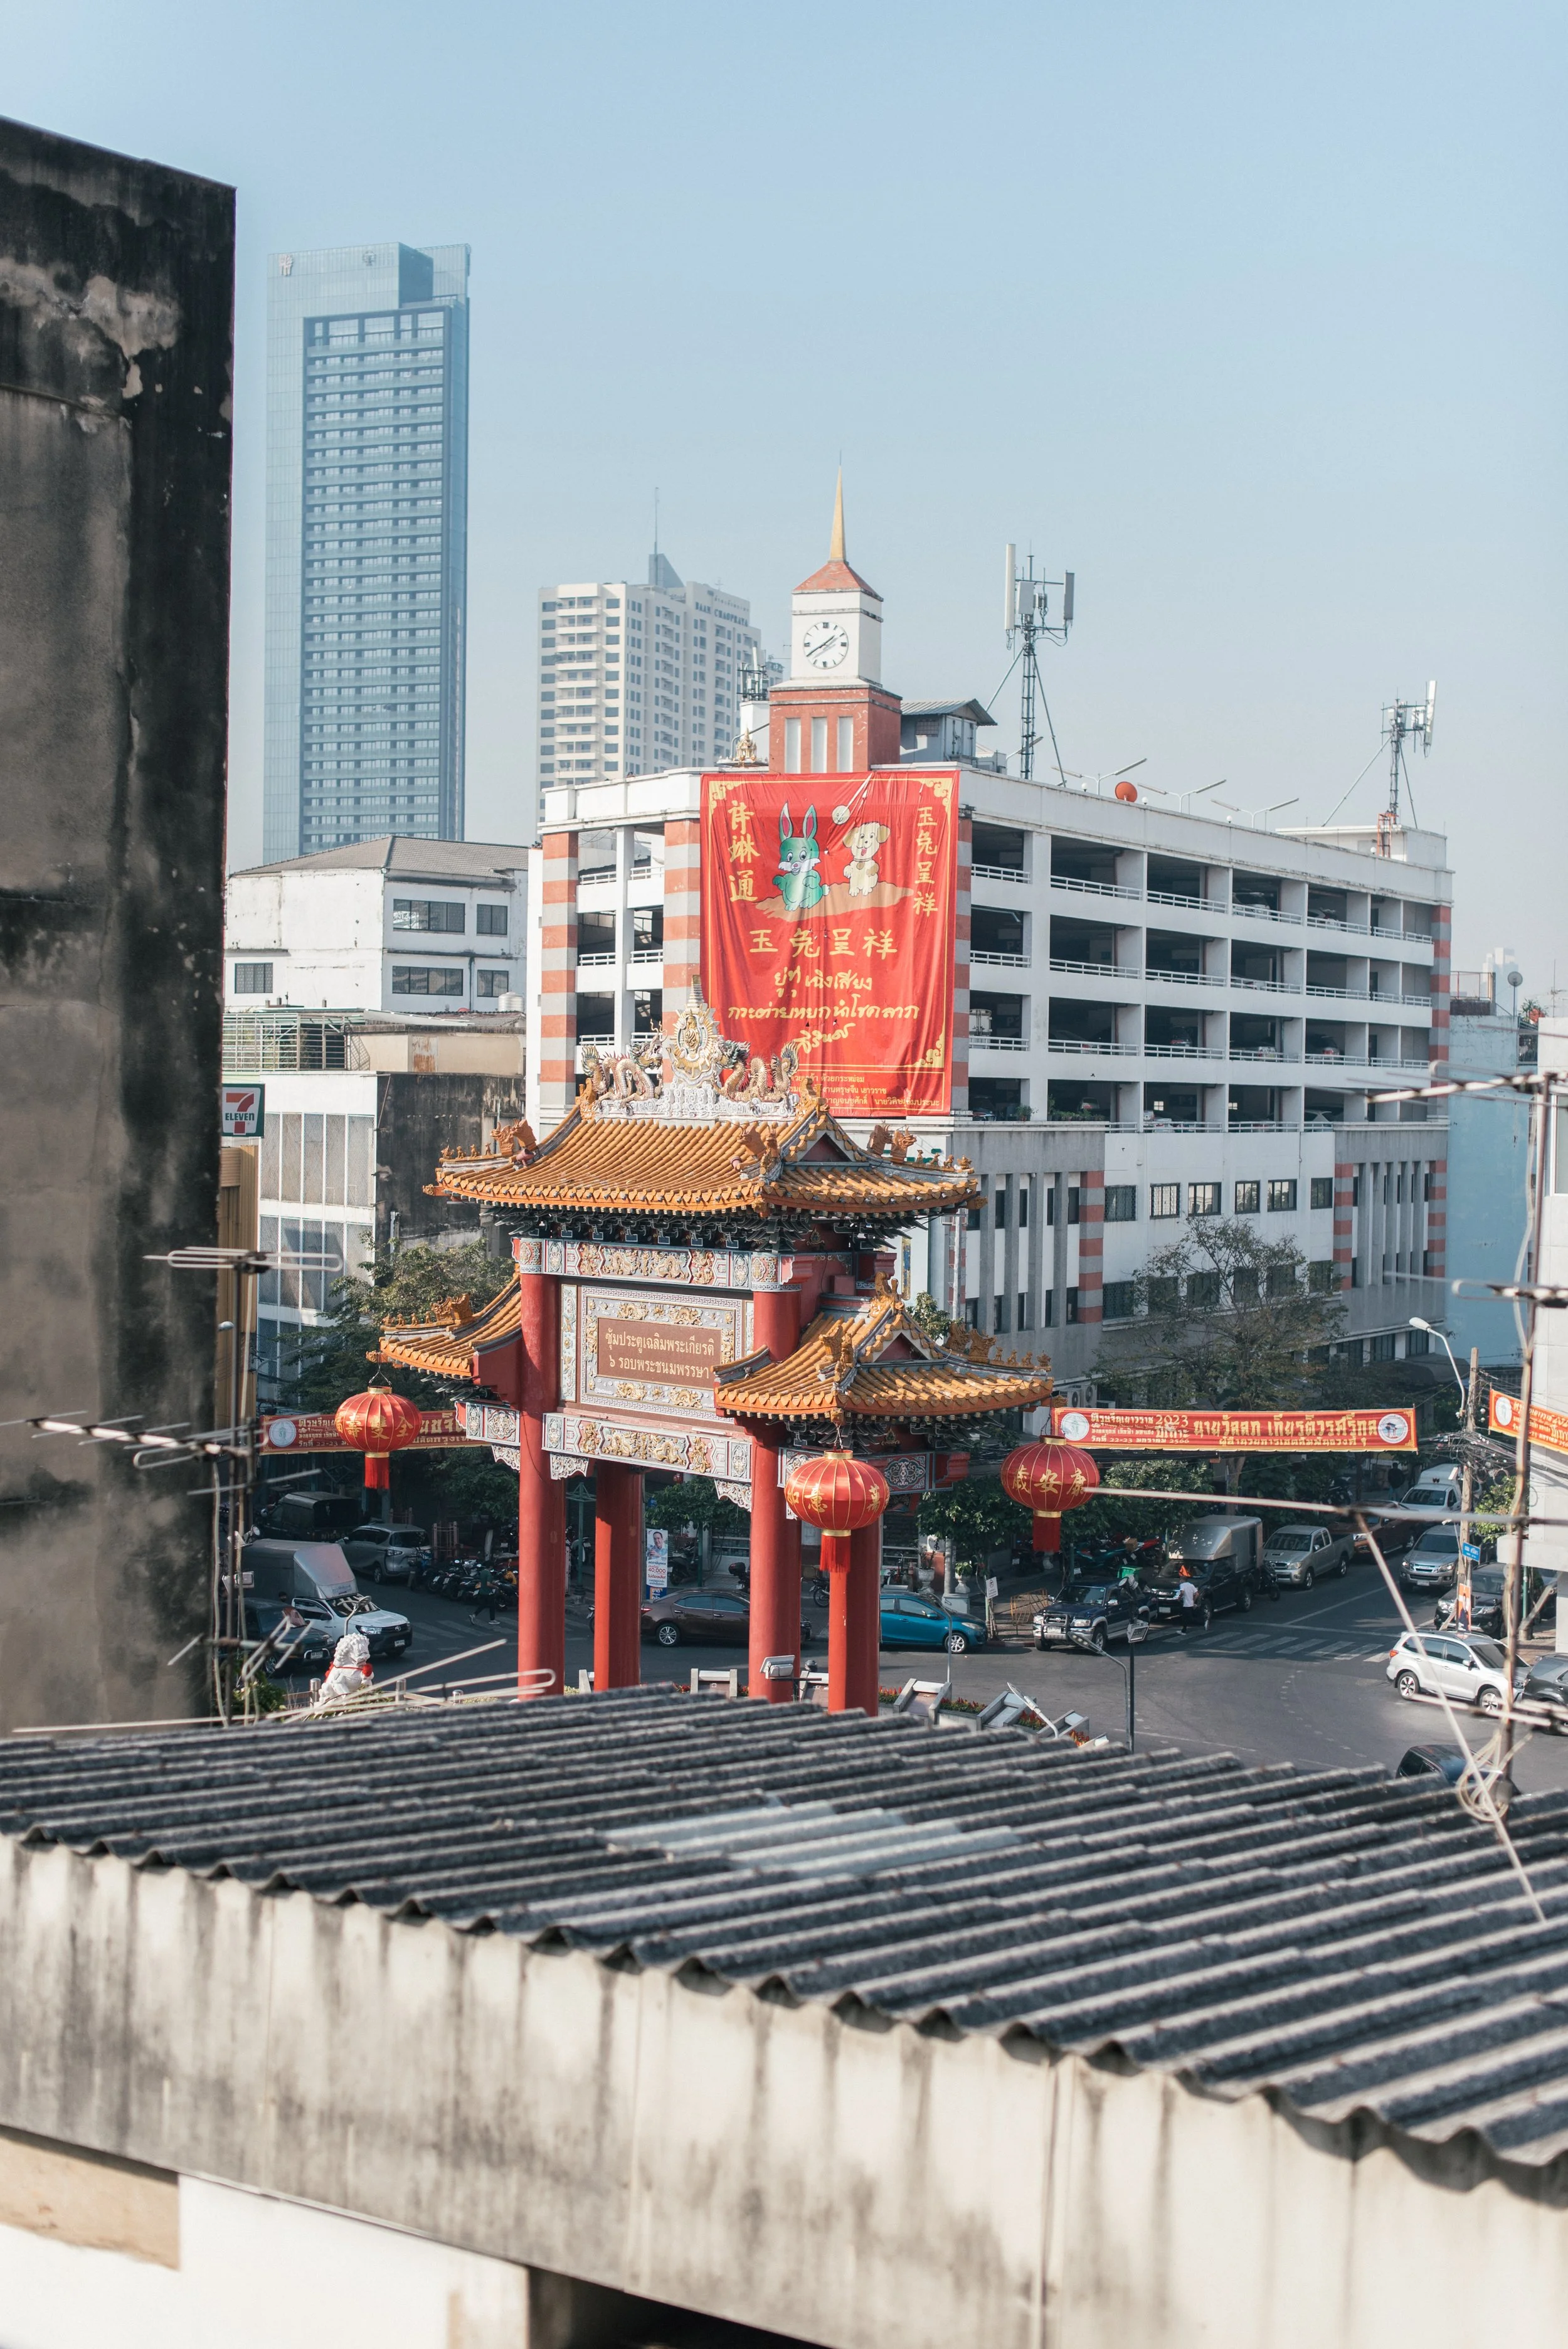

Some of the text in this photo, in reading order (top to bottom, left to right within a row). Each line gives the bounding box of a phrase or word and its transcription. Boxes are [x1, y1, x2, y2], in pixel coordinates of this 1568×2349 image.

[605, 1328, 714, 1357] ซุ้มประตูเฉลิมพระเกียรติ
[618, 1355, 709, 1379] รอบพระชนมพรรษา
[1155, 1414, 1189, 1428] 2023
